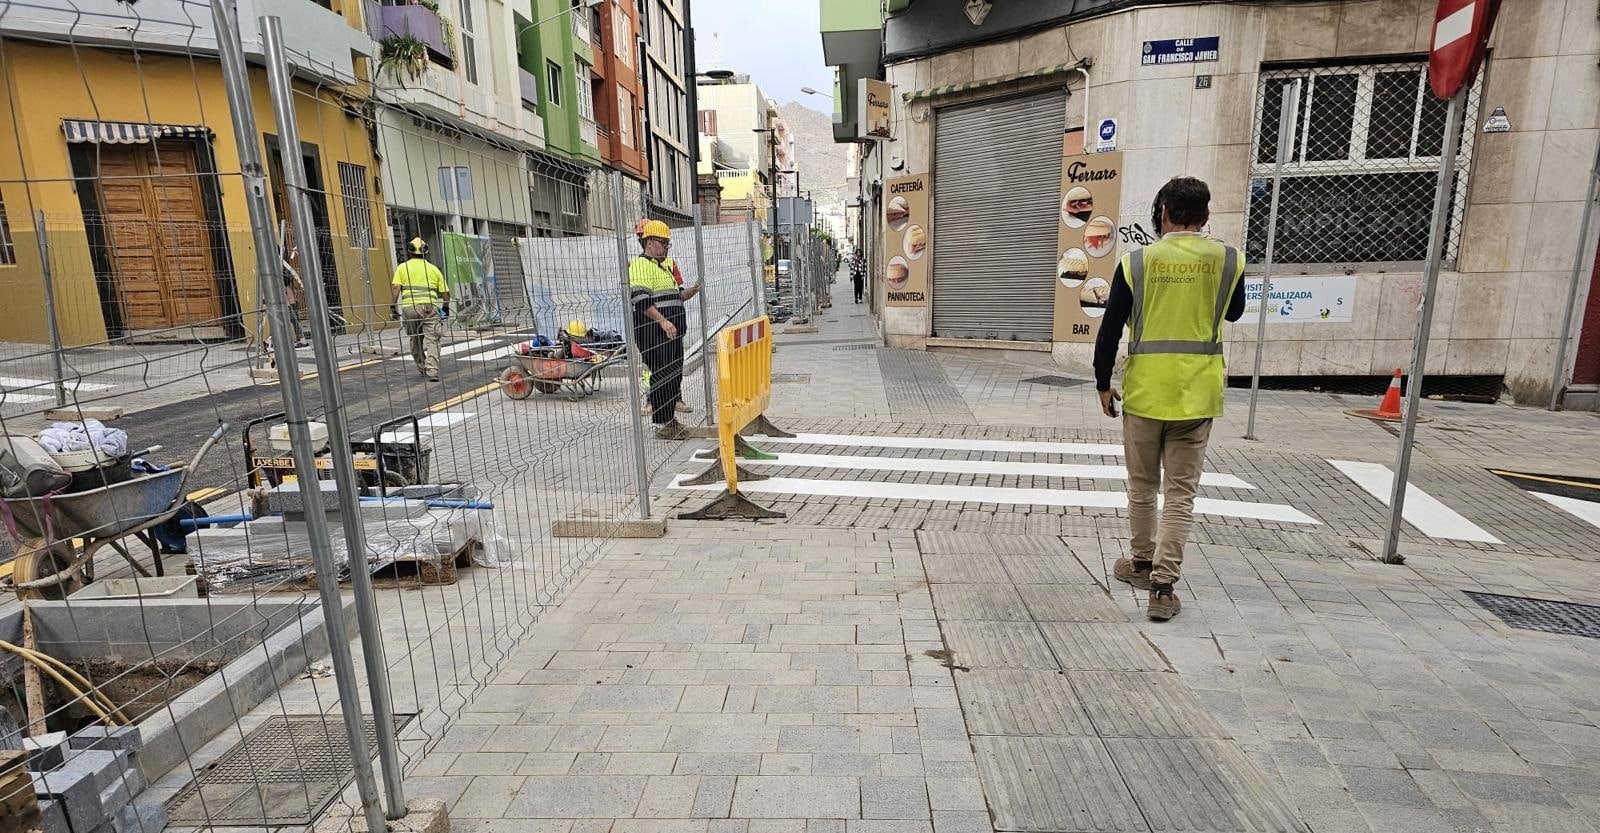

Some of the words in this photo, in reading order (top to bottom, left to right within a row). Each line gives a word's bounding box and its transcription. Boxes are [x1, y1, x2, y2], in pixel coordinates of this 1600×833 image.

[1143, 54, 1156, 64] SAN
[1158, 52, 1193, 63] FRANCISCO
[1195, 51, 1217, 60] JAVIER
[1198, 76, 1208, 87] 26
[1067, 160, 1118, 184] Ferraro
[890, 179, 924, 194] CAFETERÍA
[1151, 259, 1217, 275] ferrovial
[1151, 275, 1195, 284] construcción
[1244, 283, 1274, 291] ISITS
[887, 291, 925, 302] PANINOTECA
[1246, 291, 1313, 300] ERSNALIZADA
[1072, 323, 1090, 336] BAR
